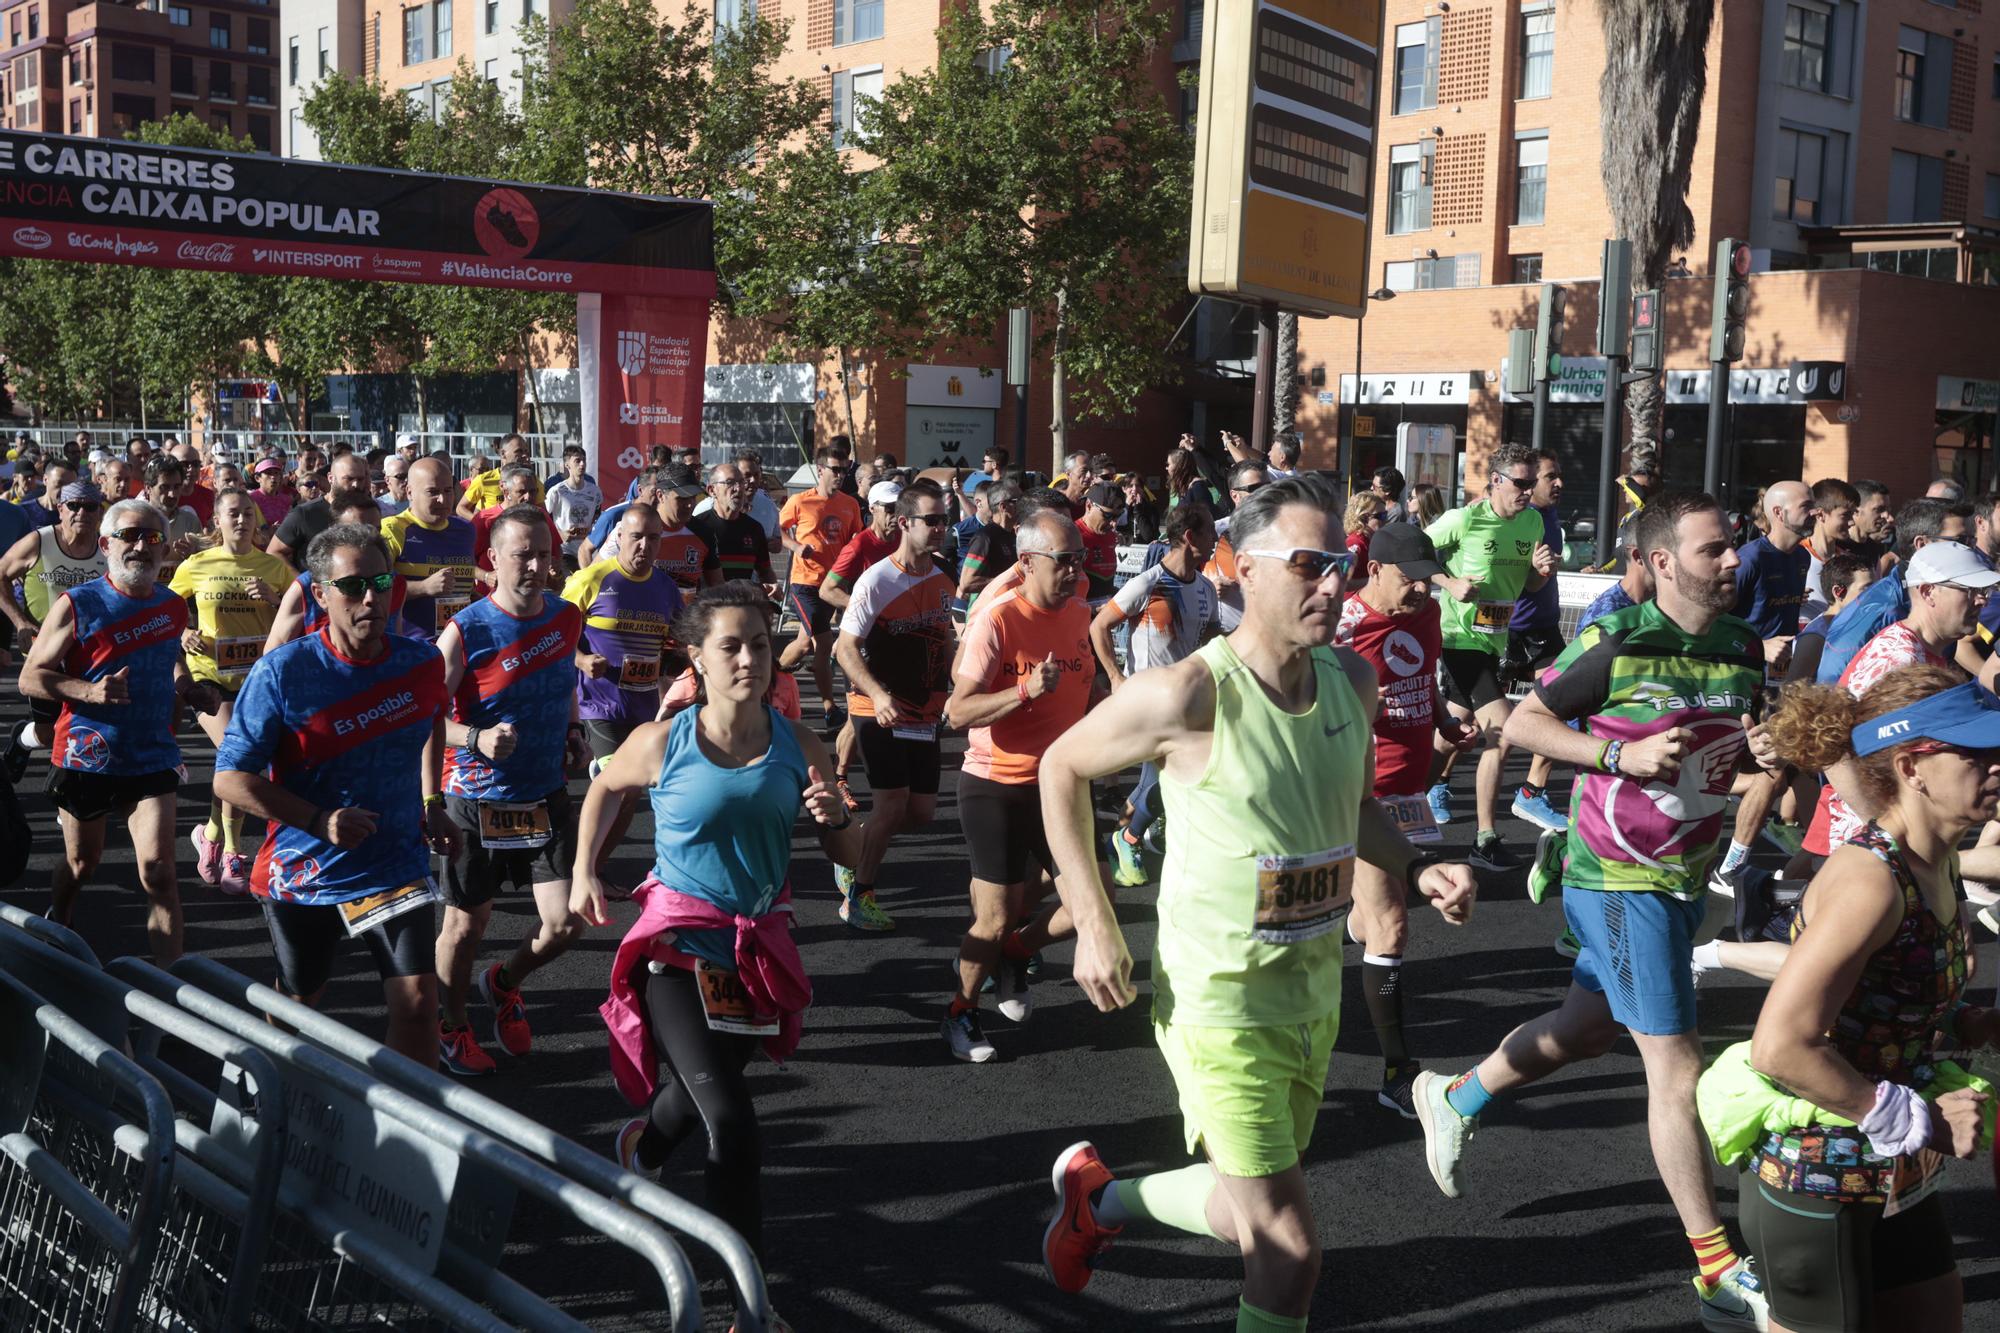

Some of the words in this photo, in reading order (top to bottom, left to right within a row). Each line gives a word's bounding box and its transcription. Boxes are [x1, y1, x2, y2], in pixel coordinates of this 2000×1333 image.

[24, 143, 236, 192] CARRERES
[0, 180, 73, 208] NCIA
[213, 198, 381, 237] POPULAR
[268, 250, 364, 270] INTERSPORT
[384, 258, 422, 269] aspaym
[441, 261, 573, 284] #ValènciaCorre
[650, 336, 689, 346] Fundació
[650, 346, 690, 357] Esportiva
[650, 356, 690, 368] Municipal
[1563, 367, 1606, 380] Urban
[1551, 383, 1605, 397] unning
[641, 405, 668, 414] caixa
[641, 415, 683, 425] popular
[113, 630, 131, 645] Es
[134, 613, 172, 640] posible
[502, 658, 520, 672] Es
[523, 630, 563, 665] posible
[1003, 658, 1082, 677] RUNING
[1385, 676, 1424, 696] CIRCUIT
[333, 719, 355, 737] Es
[357, 690, 414, 726] posible
[385, 703, 419, 724] Valencia
[1276, 863, 1340, 908] 3481
